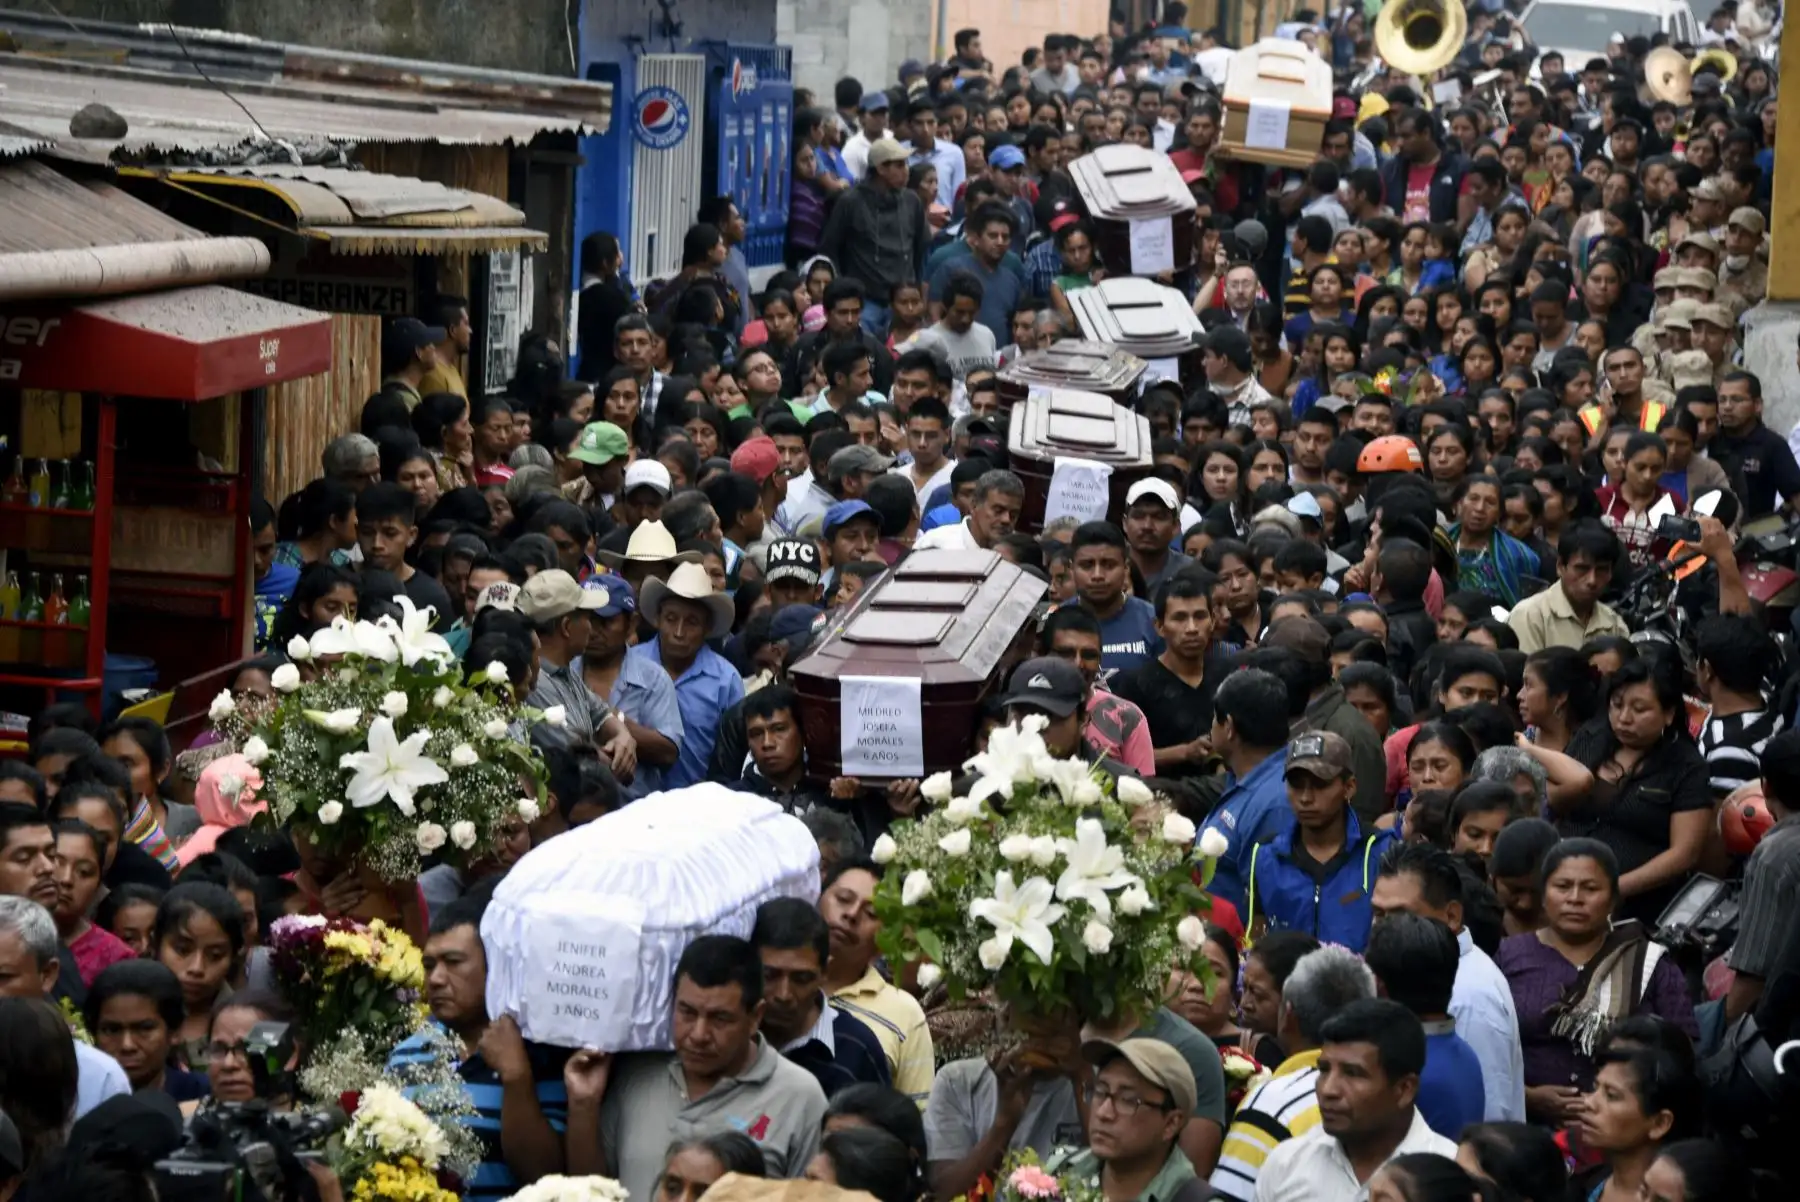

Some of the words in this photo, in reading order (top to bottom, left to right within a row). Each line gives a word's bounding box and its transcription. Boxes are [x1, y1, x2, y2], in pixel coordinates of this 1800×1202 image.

[0, 315, 61, 347] er
[770, 541, 814, 563] NYC
[858, 706, 902, 718] MILDRED
[857, 736, 904, 747] MORALES
[863, 752, 870, 761] 6
[871, 750, 900, 762] AÑOS
[556, 940, 607, 958] JENIFER
[552, 960, 606, 979] ANDREA
[546, 980, 609, 1000] MORALES
[552, 1003, 560, 1016] 3
[564, 1003, 600, 1021] AÑOS
